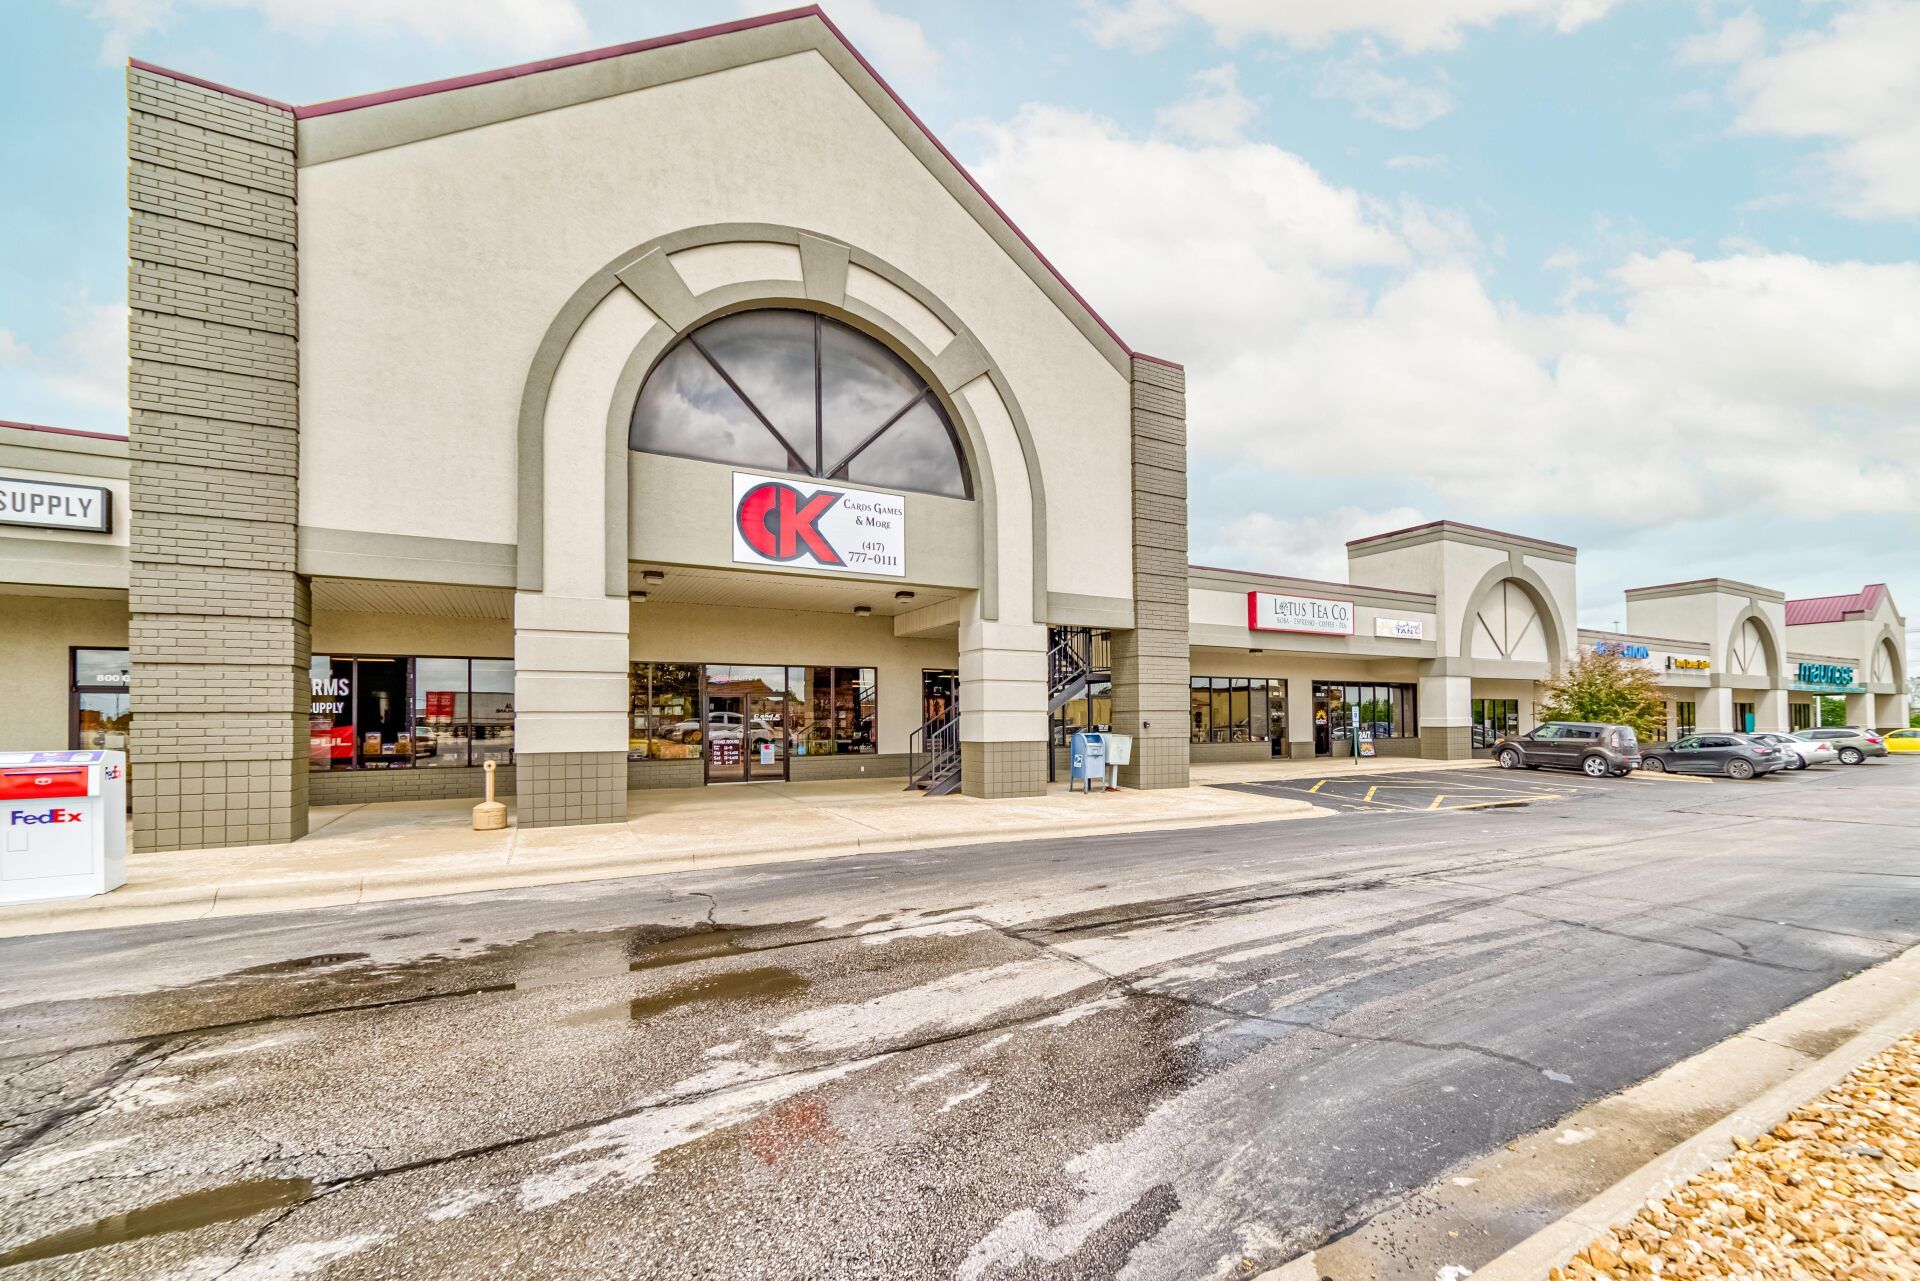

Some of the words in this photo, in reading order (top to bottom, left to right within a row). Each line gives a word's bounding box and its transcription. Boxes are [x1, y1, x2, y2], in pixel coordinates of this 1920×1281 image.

[736, 481, 848, 567] CK
[855, 515, 864, 526] &
[862, 540, 885, 553] (417)
[848, 551, 898, 566] 777-0111
[96, 674, 120, 682] 800
[310, 702, 344, 714] UPPLY
[11, 808, 83, 825] FedEx
